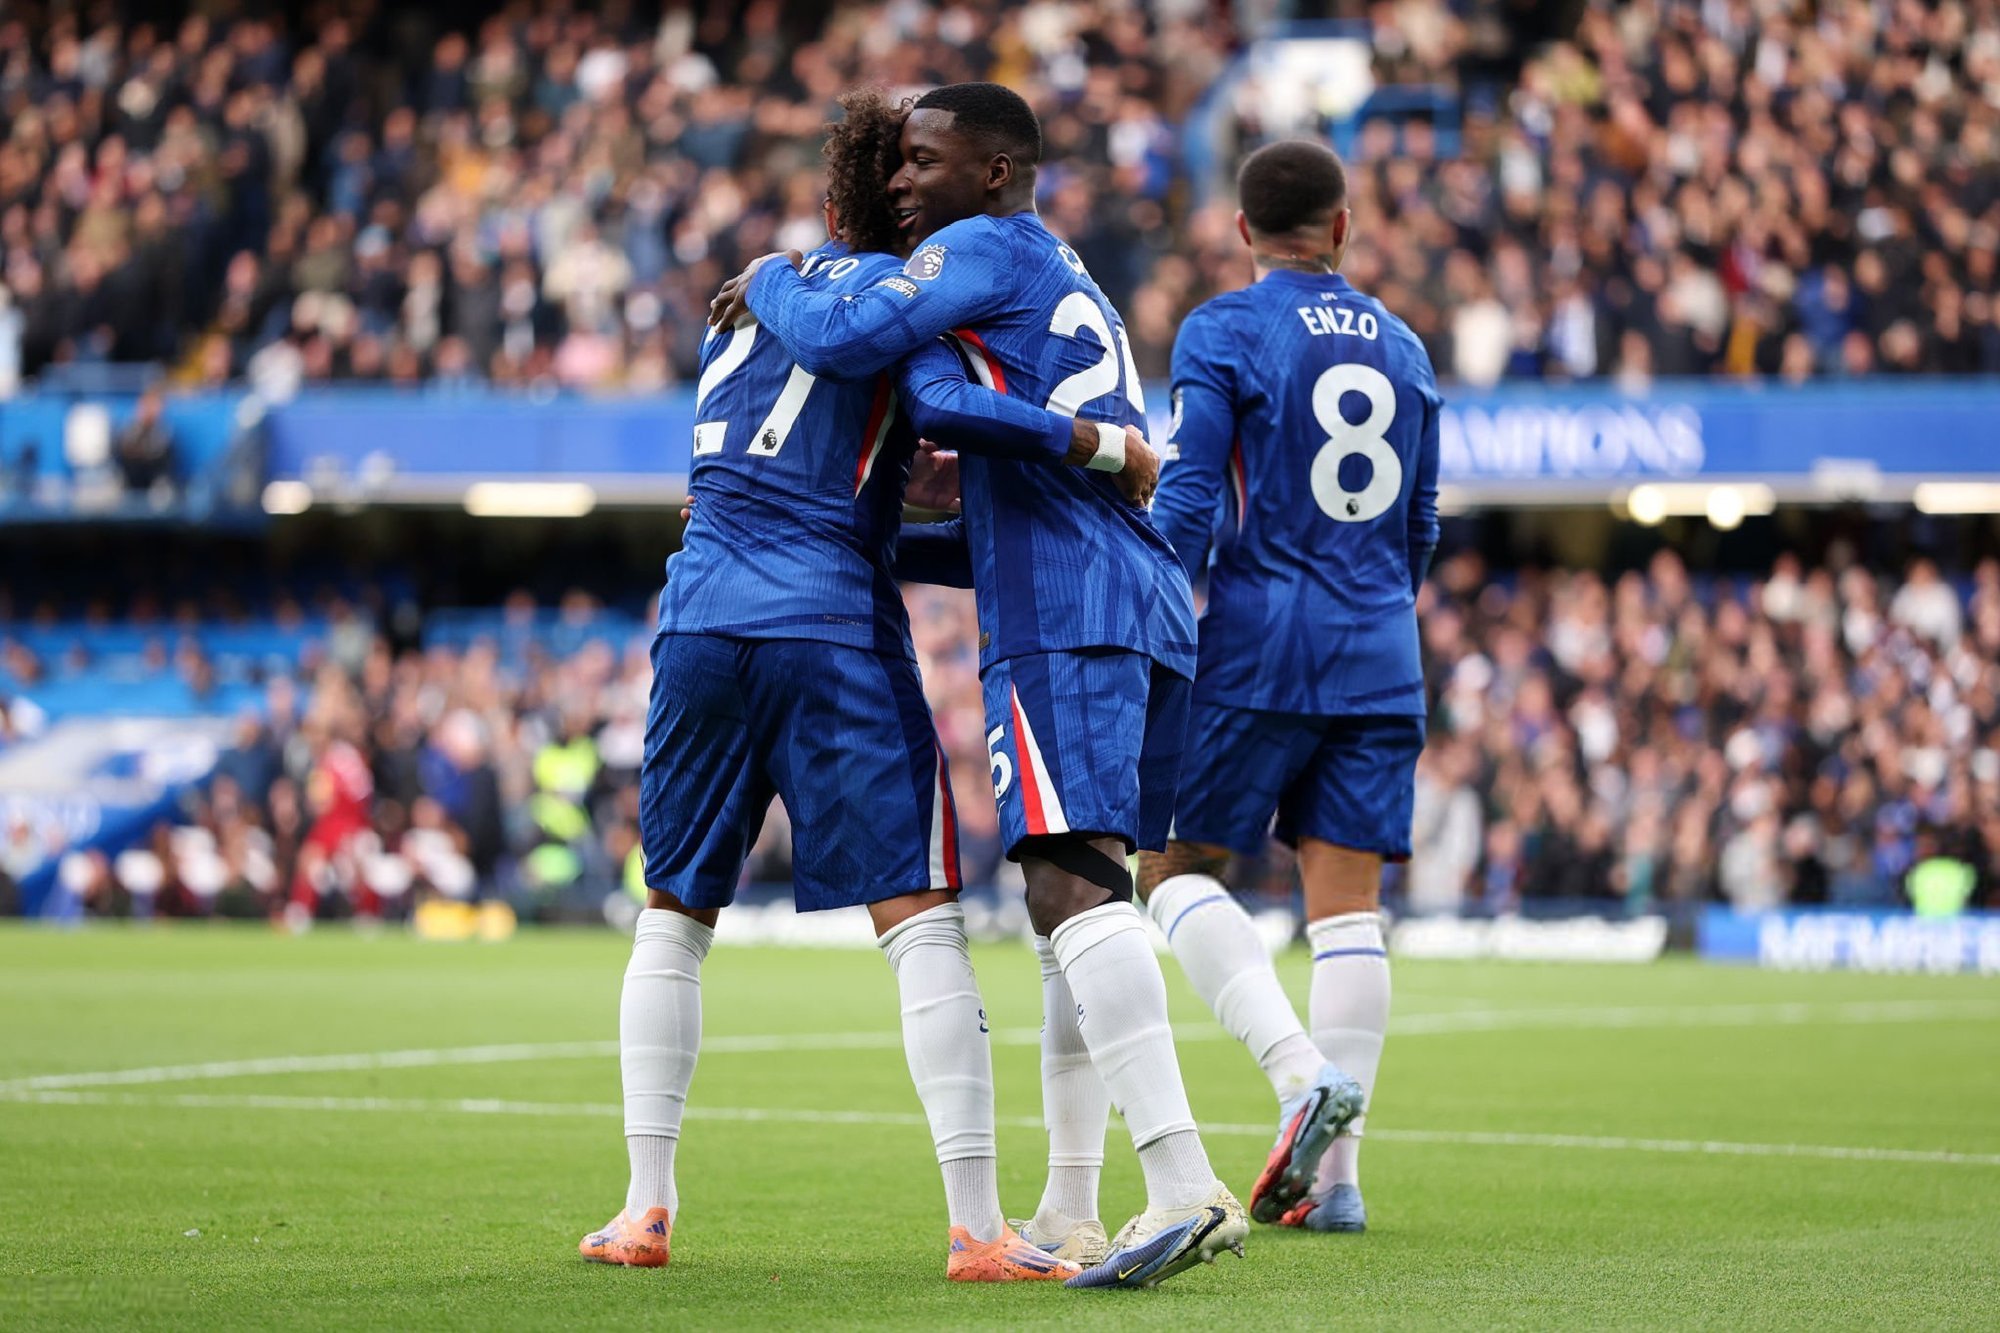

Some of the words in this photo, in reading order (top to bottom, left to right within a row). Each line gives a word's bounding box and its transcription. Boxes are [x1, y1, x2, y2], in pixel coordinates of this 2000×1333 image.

[1297, 306, 1378, 340] ENZO
[1310, 363, 1402, 522] 8
[987, 724, 1012, 799] 5
